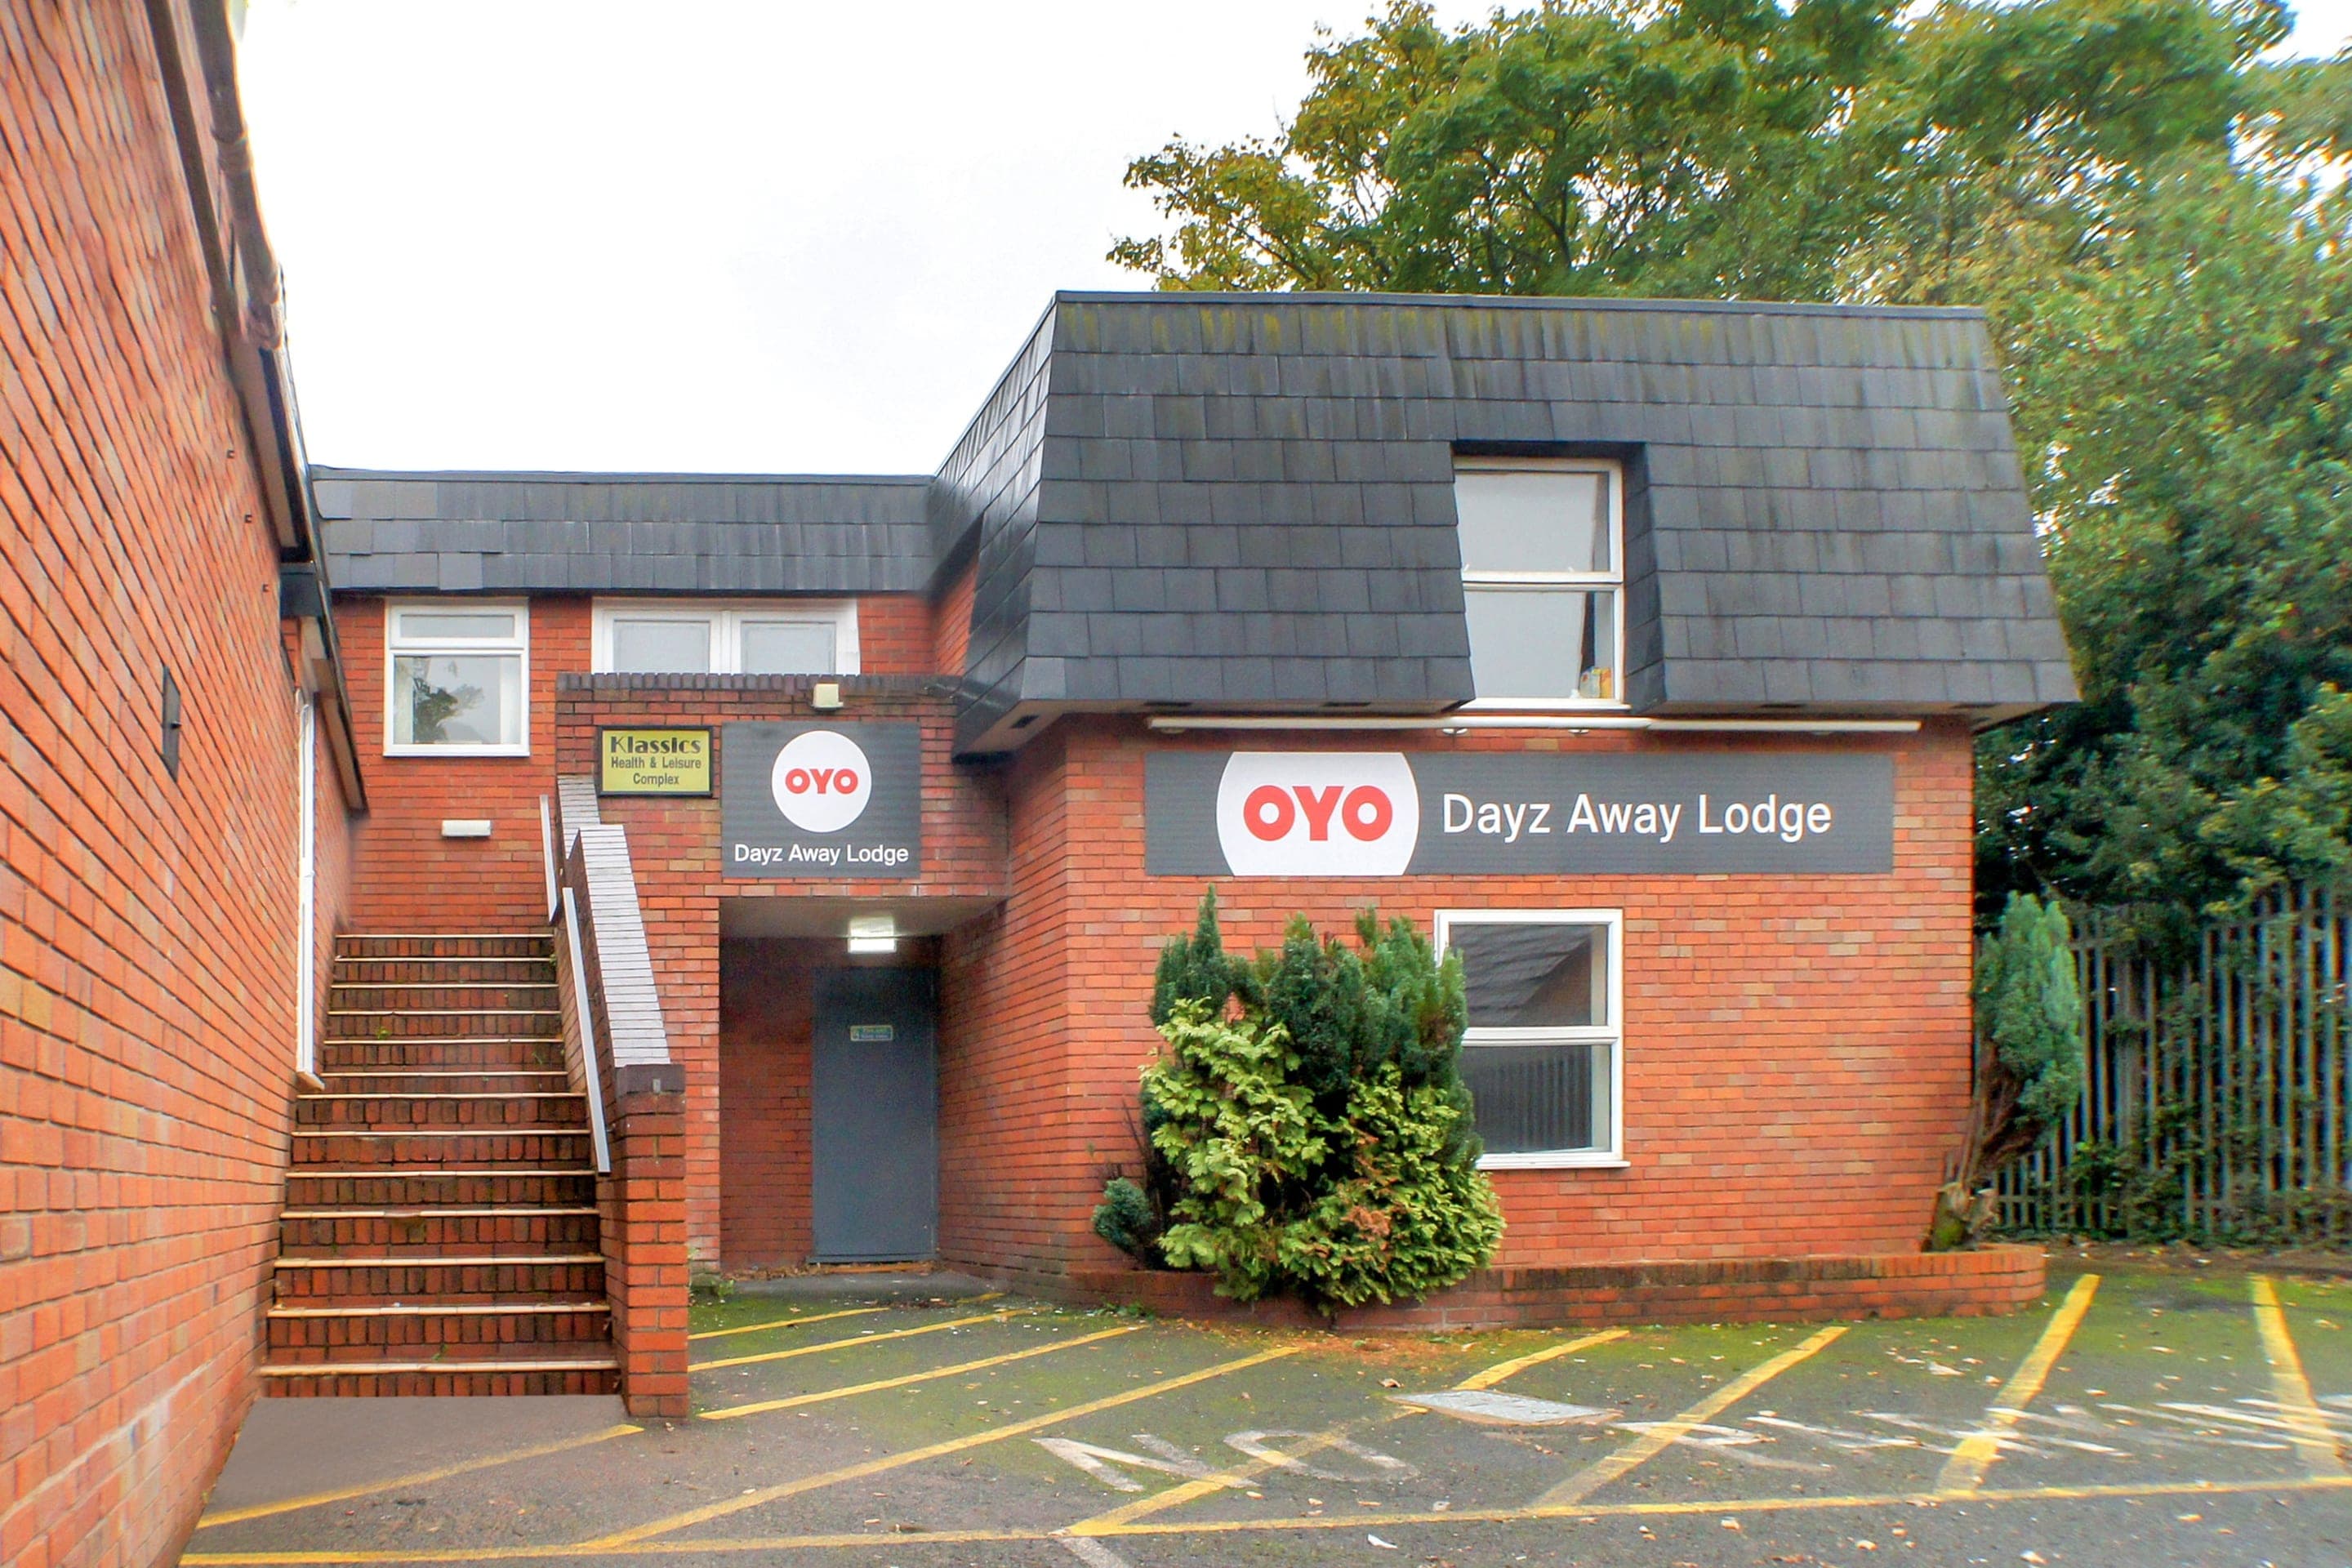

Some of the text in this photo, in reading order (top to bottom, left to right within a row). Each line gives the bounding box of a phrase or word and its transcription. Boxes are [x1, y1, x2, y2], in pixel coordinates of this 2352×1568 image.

[610, 736, 702, 754] Klassics
[611, 756, 702, 768] Health & Leisure
[633, 773, 679, 787] Complex
[785, 768, 858, 795] OYO
[1243, 785, 1833, 844] OYO Dayz Away Lodge
[734, 844, 910, 866] Dayz Away Lodge
